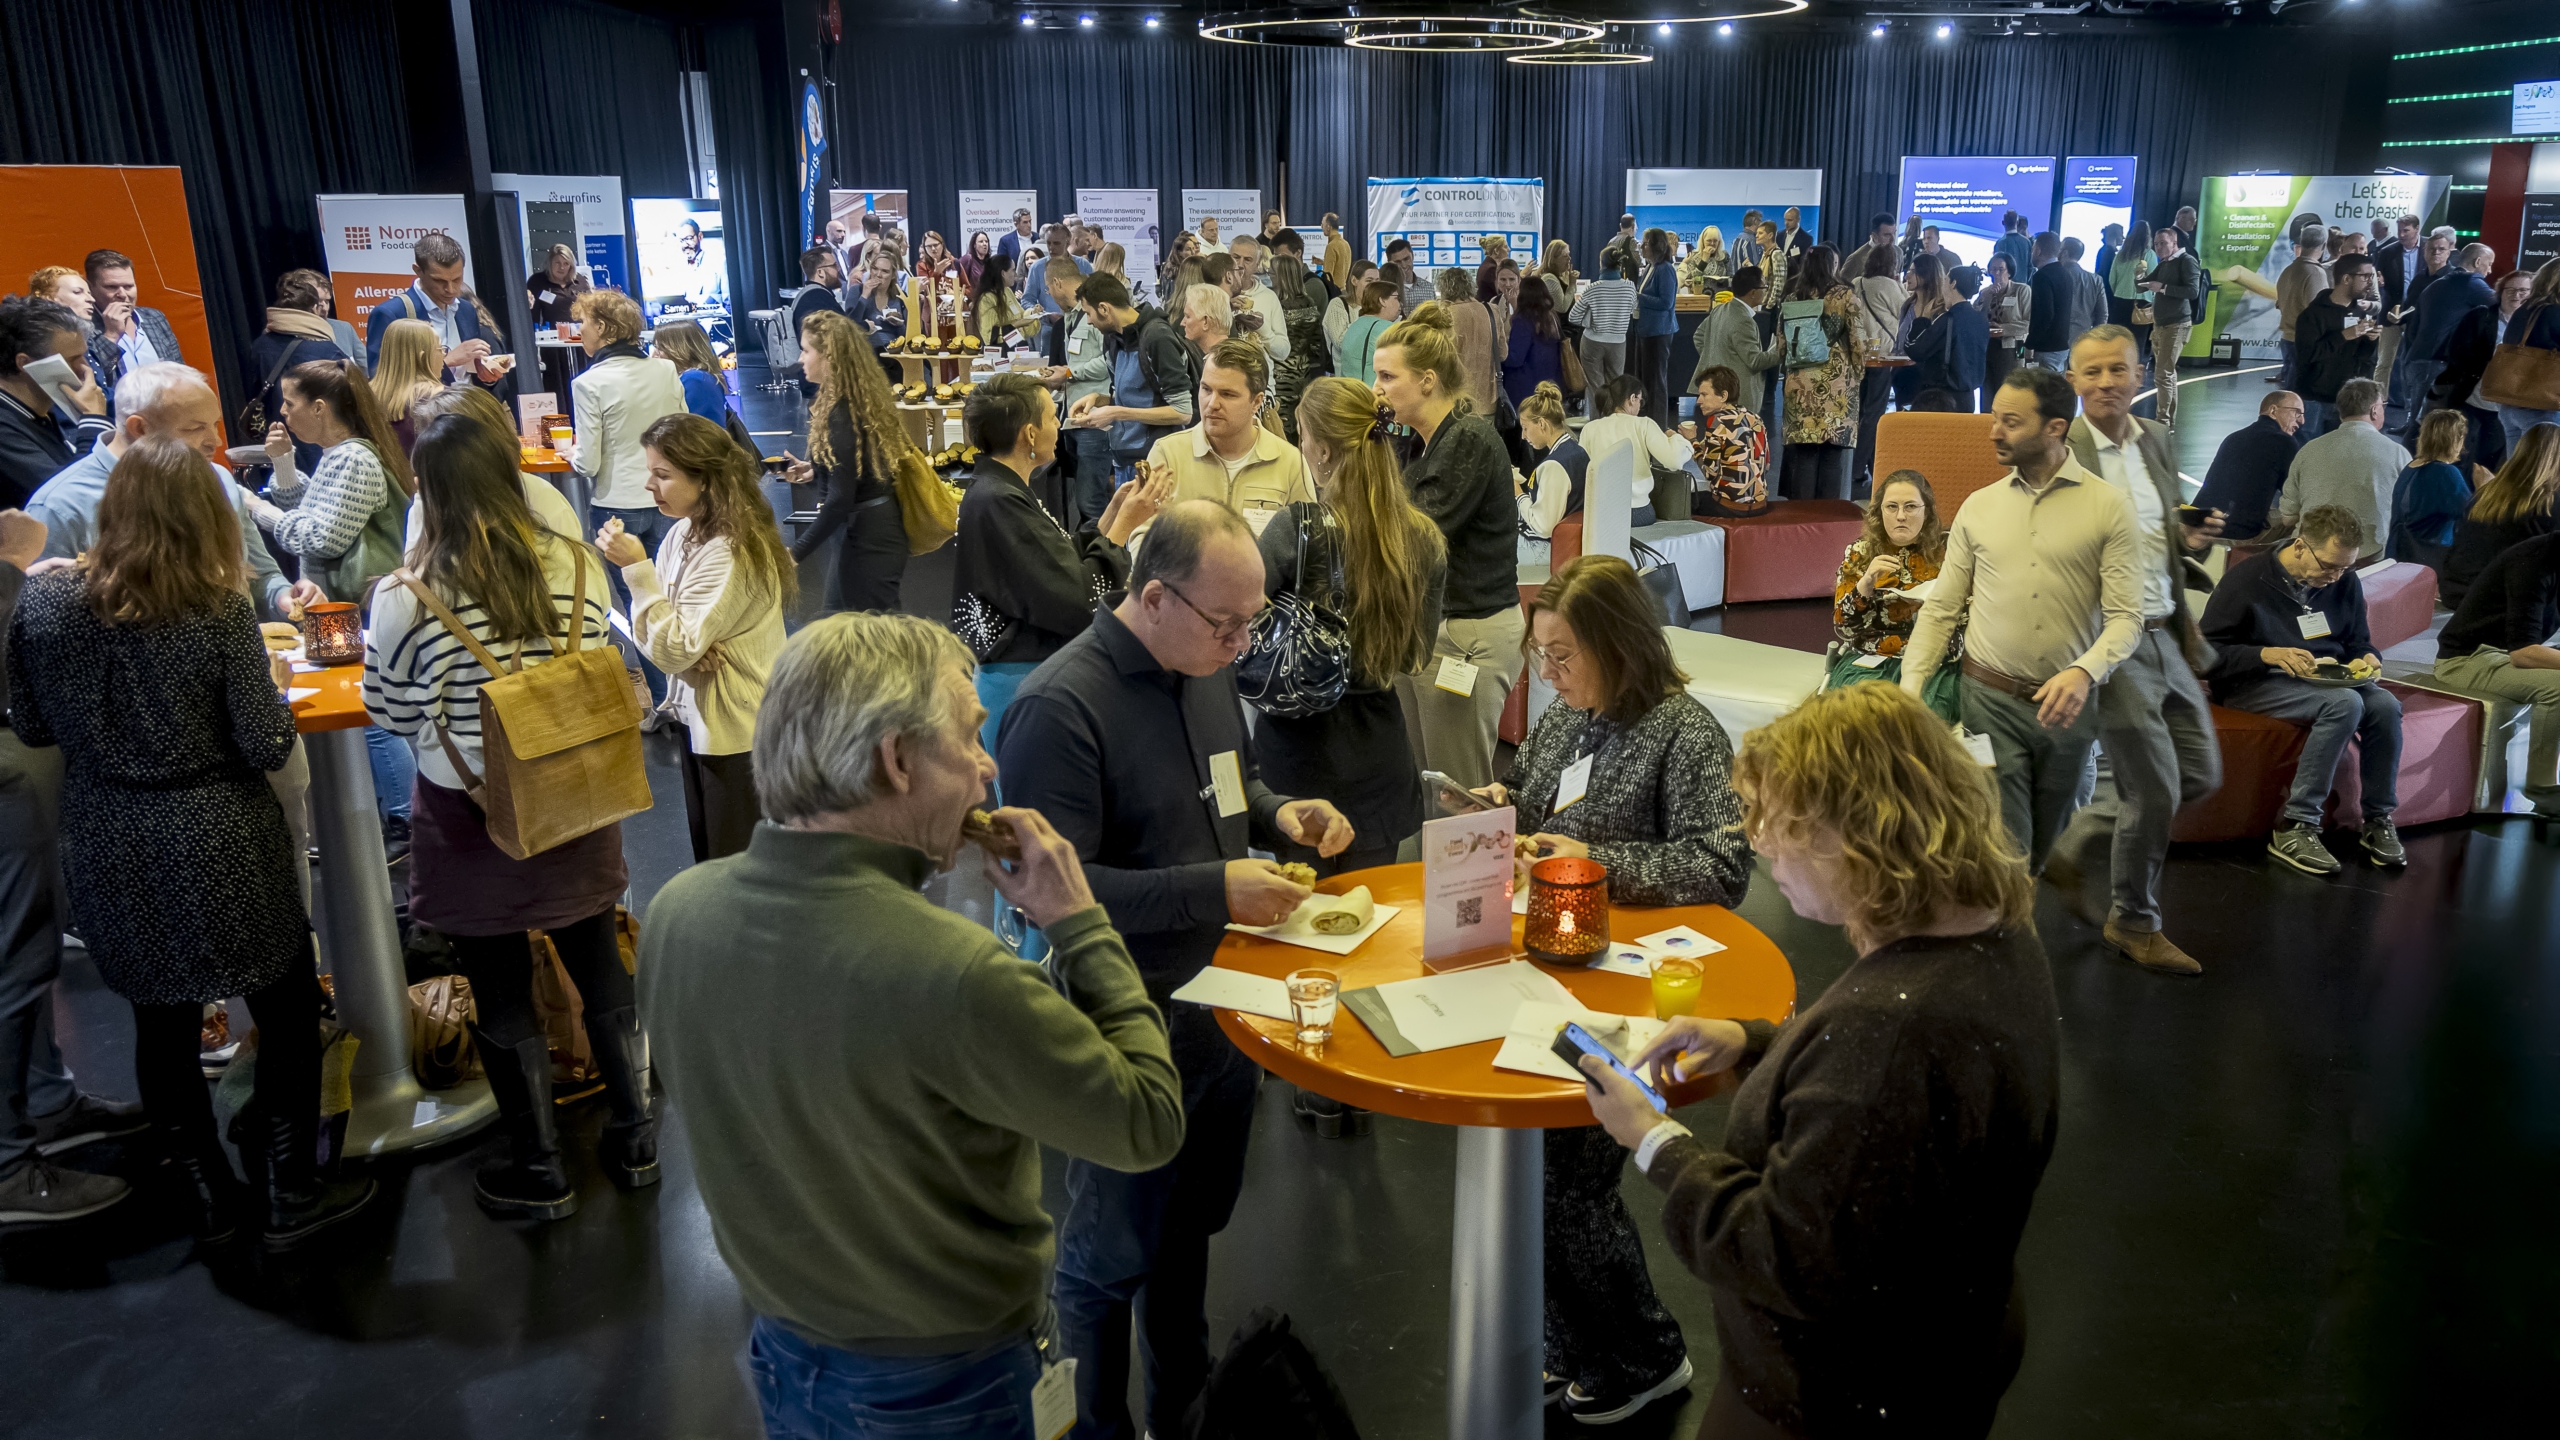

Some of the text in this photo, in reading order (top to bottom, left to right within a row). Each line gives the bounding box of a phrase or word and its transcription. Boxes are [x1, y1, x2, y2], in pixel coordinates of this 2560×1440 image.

[2351, 181, 2387, 199] Let's
[559, 192, 602, 203] eurofins
[1114, 207, 1146, 216] answering
[1222, 208, 1256, 216] experience
[2334, 201, 2363, 218] the
[980, 217, 1013, 225] compliance
[1113, 216, 1145, 224] questions
[2230, 213, 2260, 221] Cleaners
[2228, 221, 2276, 229] Disinfectants
[381, 241, 414, 250] Foodca
[2226, 244, 2260, 252] Expertise
[664, 304, 690, 313] Samen
